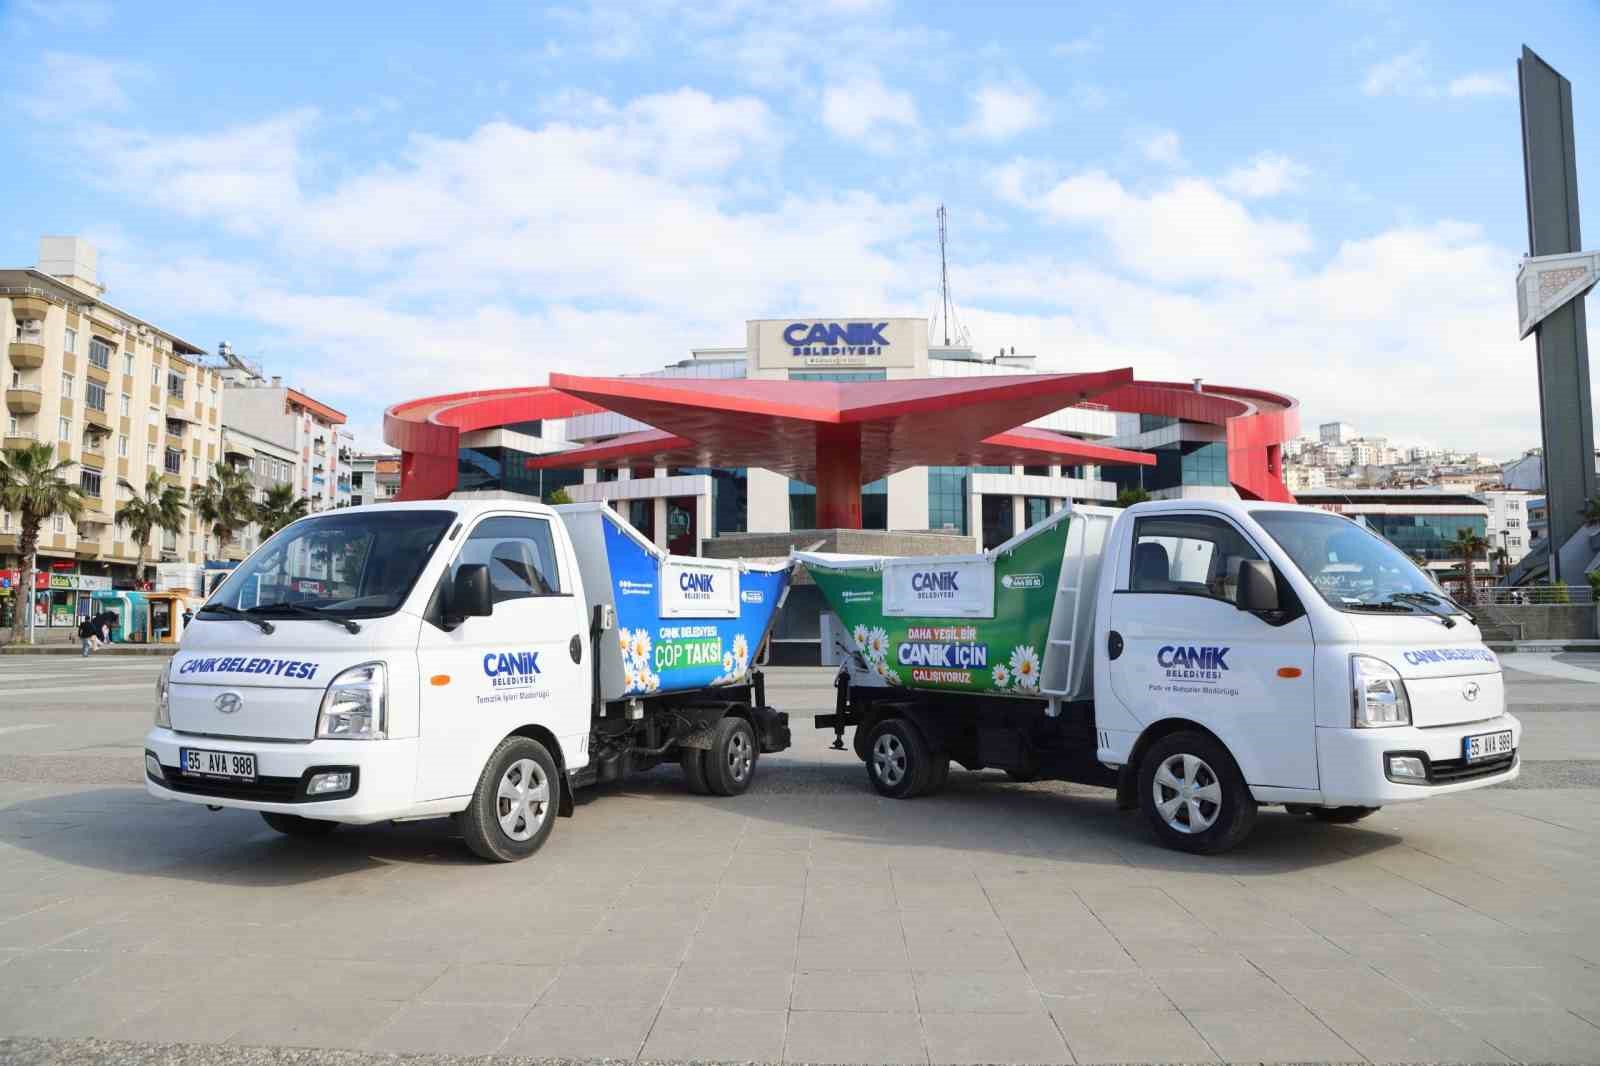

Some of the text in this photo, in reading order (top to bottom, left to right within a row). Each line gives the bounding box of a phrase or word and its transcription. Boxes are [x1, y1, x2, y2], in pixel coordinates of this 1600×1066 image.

[908, 628, 932, 640] DAHA
[960, 626, 977, 640] BİR
[655, 637, 721, 673] ÇÖP TAKSİ
[955, 641, 987, 669] İÇİN
[1471, 738, 1480, 756] 55
[1484, 736, 1497, 752] AVA
[188, 752, 253, 775] 55 AVA 988
